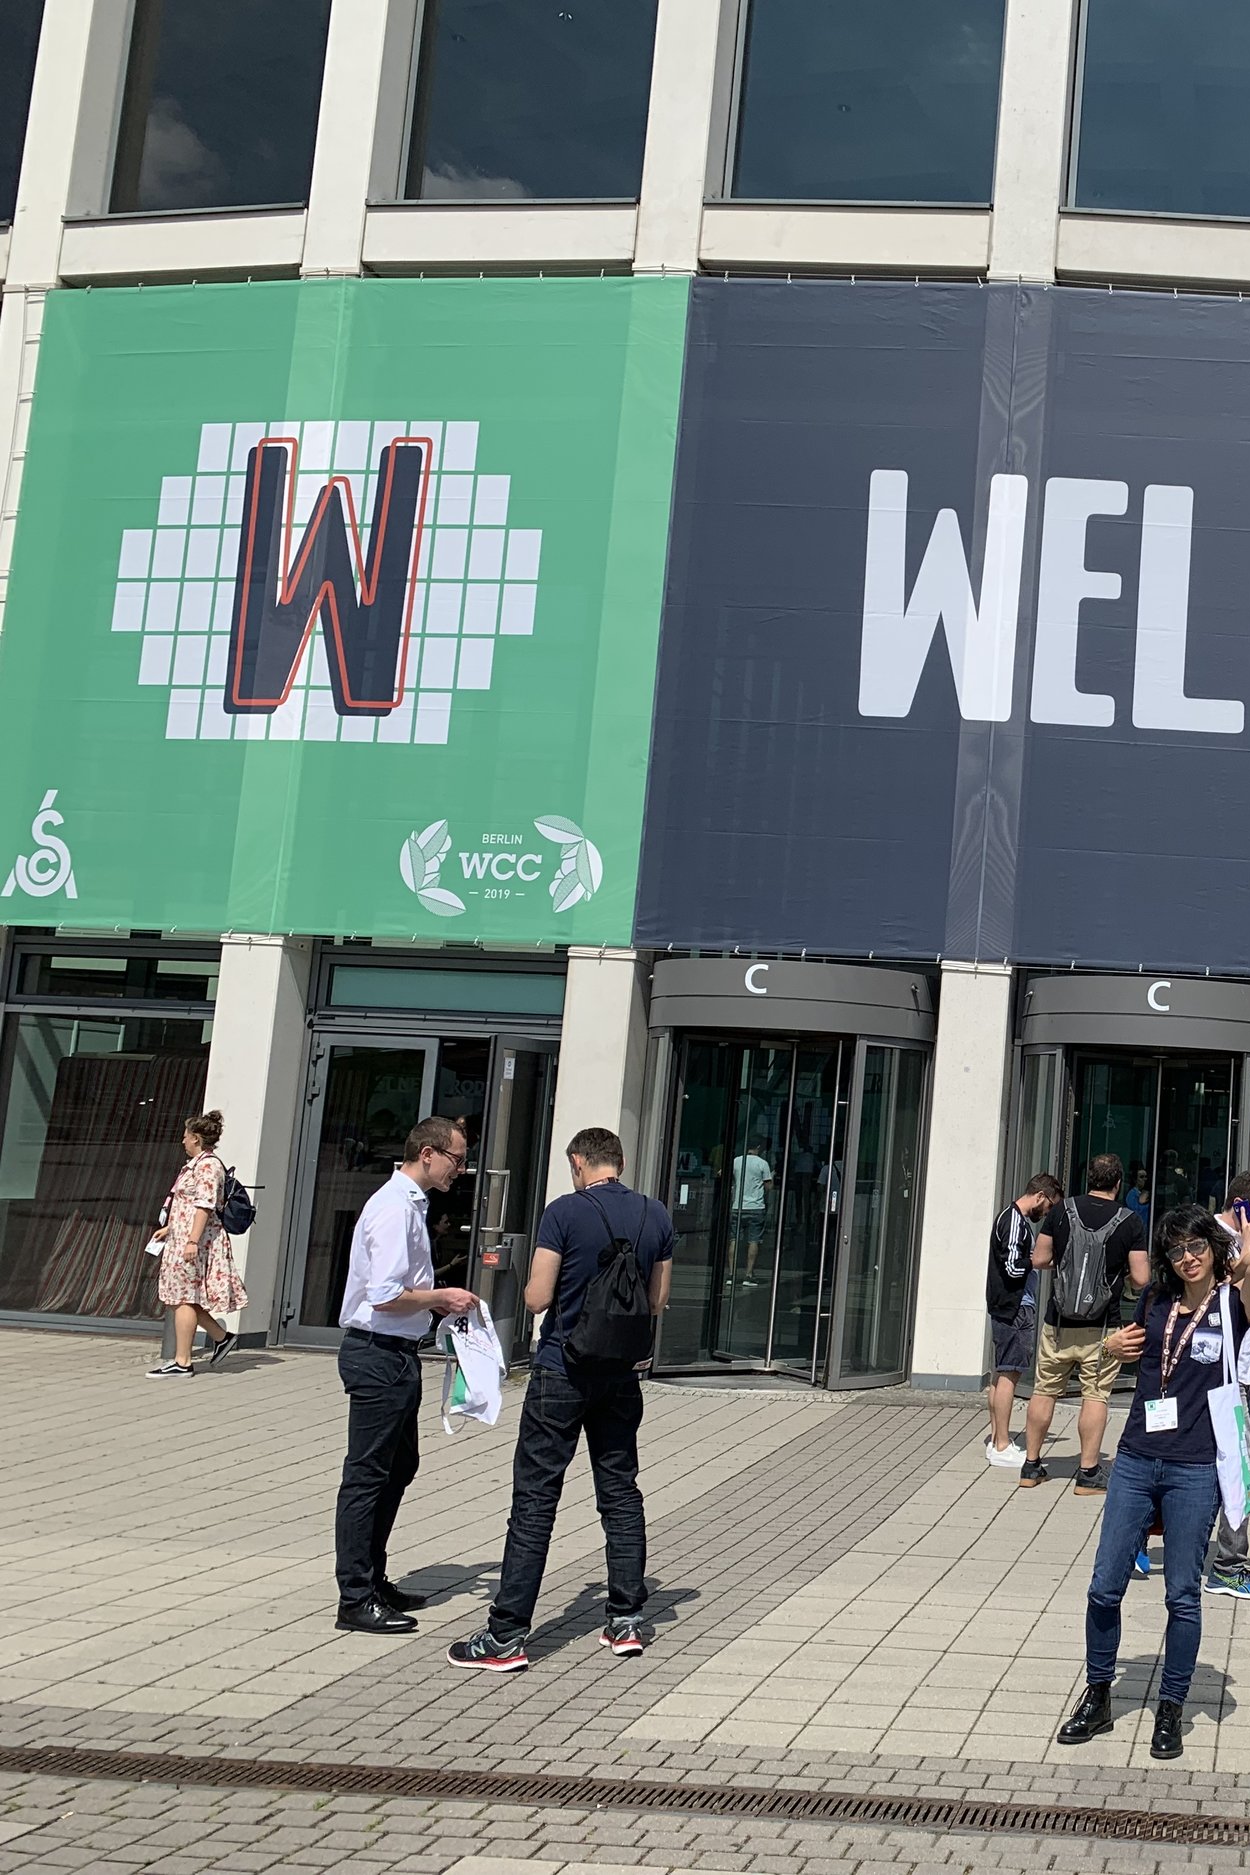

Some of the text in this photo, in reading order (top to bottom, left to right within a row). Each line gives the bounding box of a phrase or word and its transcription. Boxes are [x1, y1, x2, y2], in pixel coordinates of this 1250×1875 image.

[481, 833, 523, 845] BERLIN
[458, 852, 542, 881] WCC
[484, 888, 511, 900] 2019
[743, 963, 769, 994] C
[1147, 981, 1172, 1012] C
